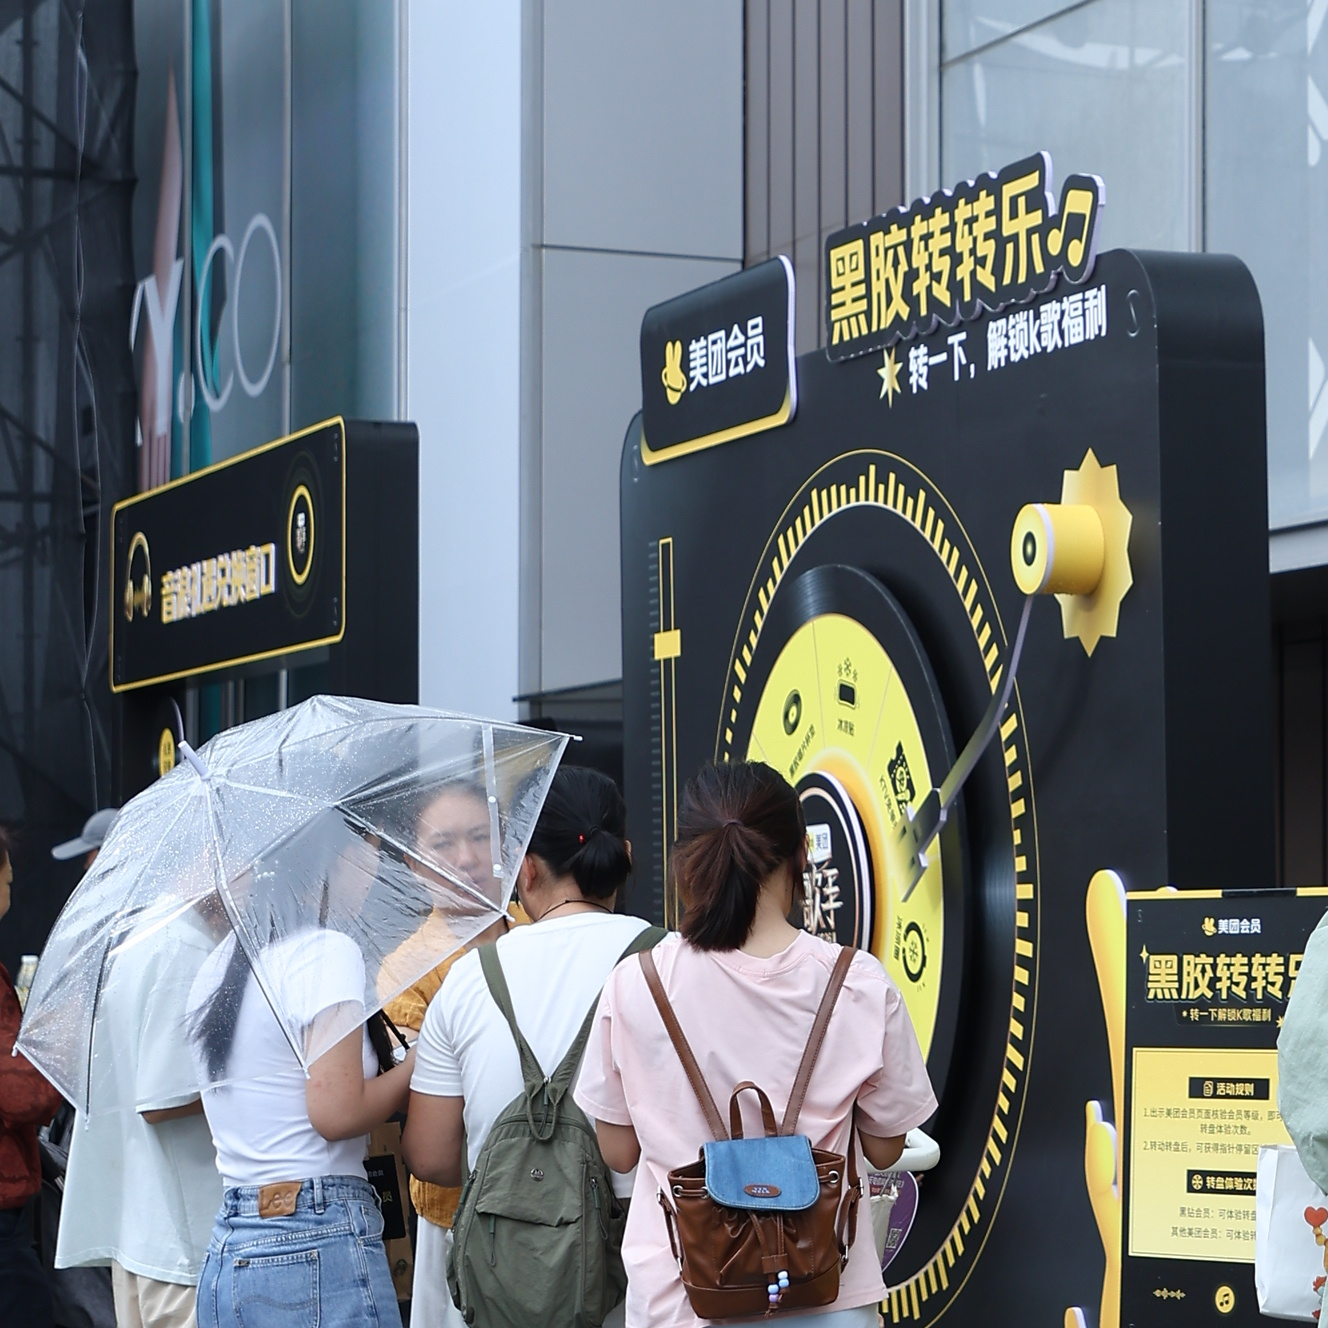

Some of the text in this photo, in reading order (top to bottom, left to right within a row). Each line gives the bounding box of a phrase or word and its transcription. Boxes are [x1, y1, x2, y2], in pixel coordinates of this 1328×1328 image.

[828, 169, 1046, 345] 黑胶转转乐
[689, 316, 765, 392] 美团会员
[1217, 918, 1262, 934] 美团会员
[1216, 1082, 1255, 1096] 活动规则
[259, 1190, 294, 1213] Lee
